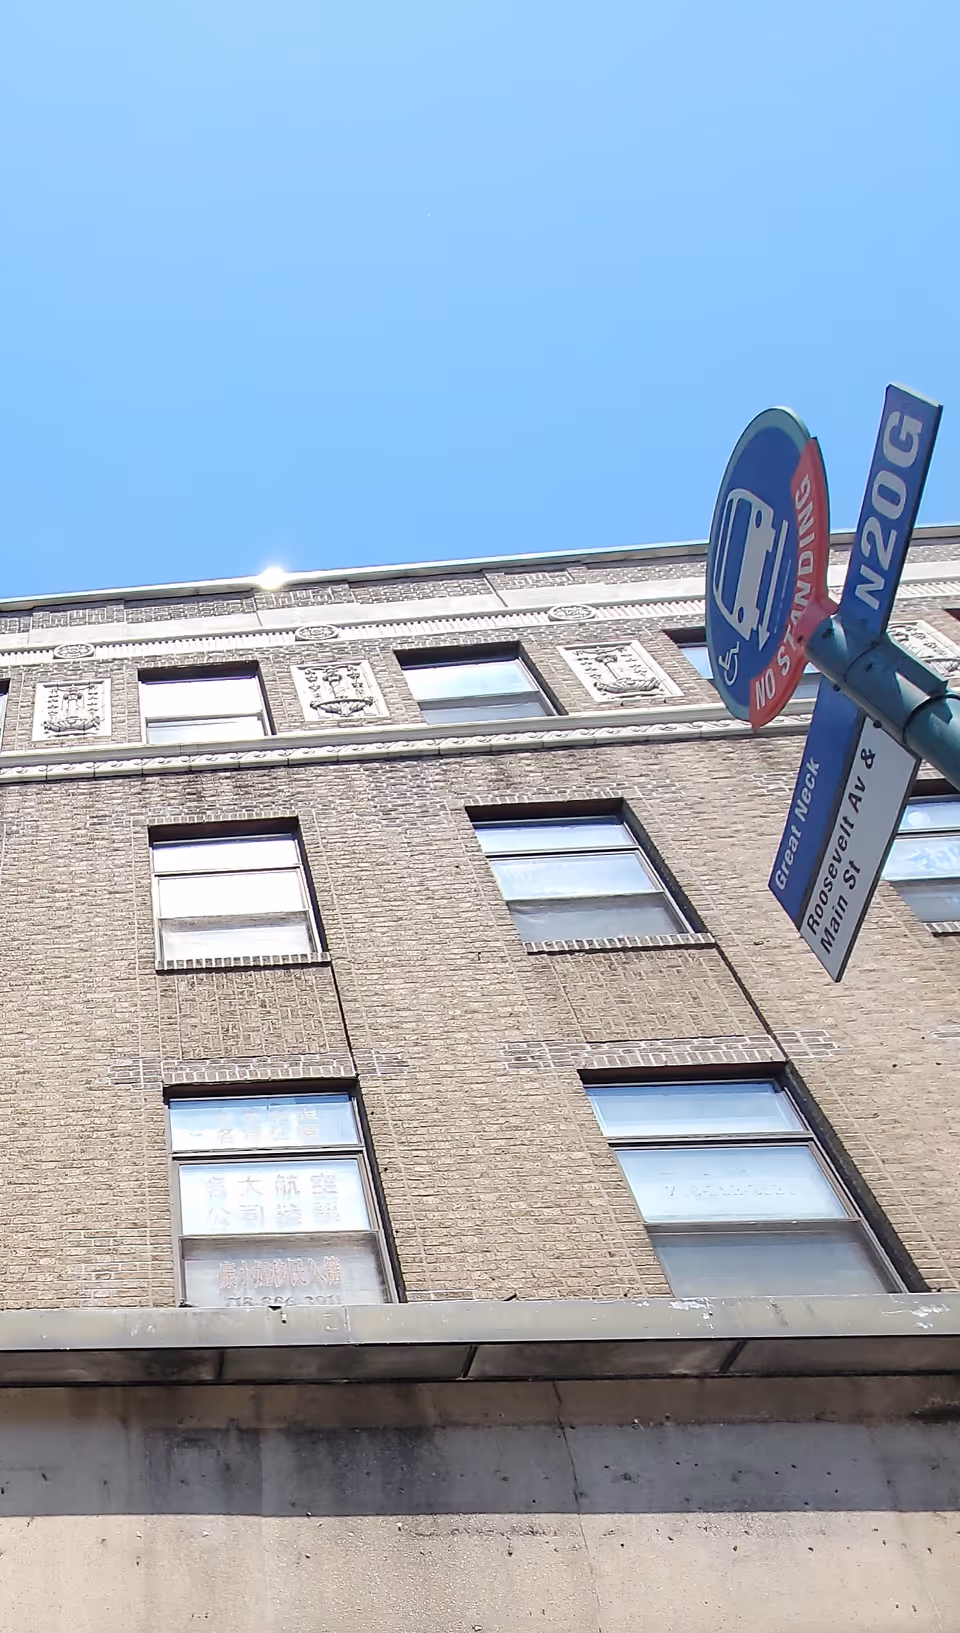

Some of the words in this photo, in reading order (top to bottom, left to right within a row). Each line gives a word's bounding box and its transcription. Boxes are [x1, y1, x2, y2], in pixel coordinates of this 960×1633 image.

[756, 667, 776, 711] NO
[777, 474, 815, 677] STANDING
[854, 410, 924, 612] N20G
[775, 824, 803, 891] Great
[794, 757, 820, 823] Neck
[807, 815, 855, 936] Roosevelt
[847, 776, 866, 813] Av
[860, 748, 876, 769] &
[819, 894, 849, 955] Main
[843, 859, 861, 890] St
